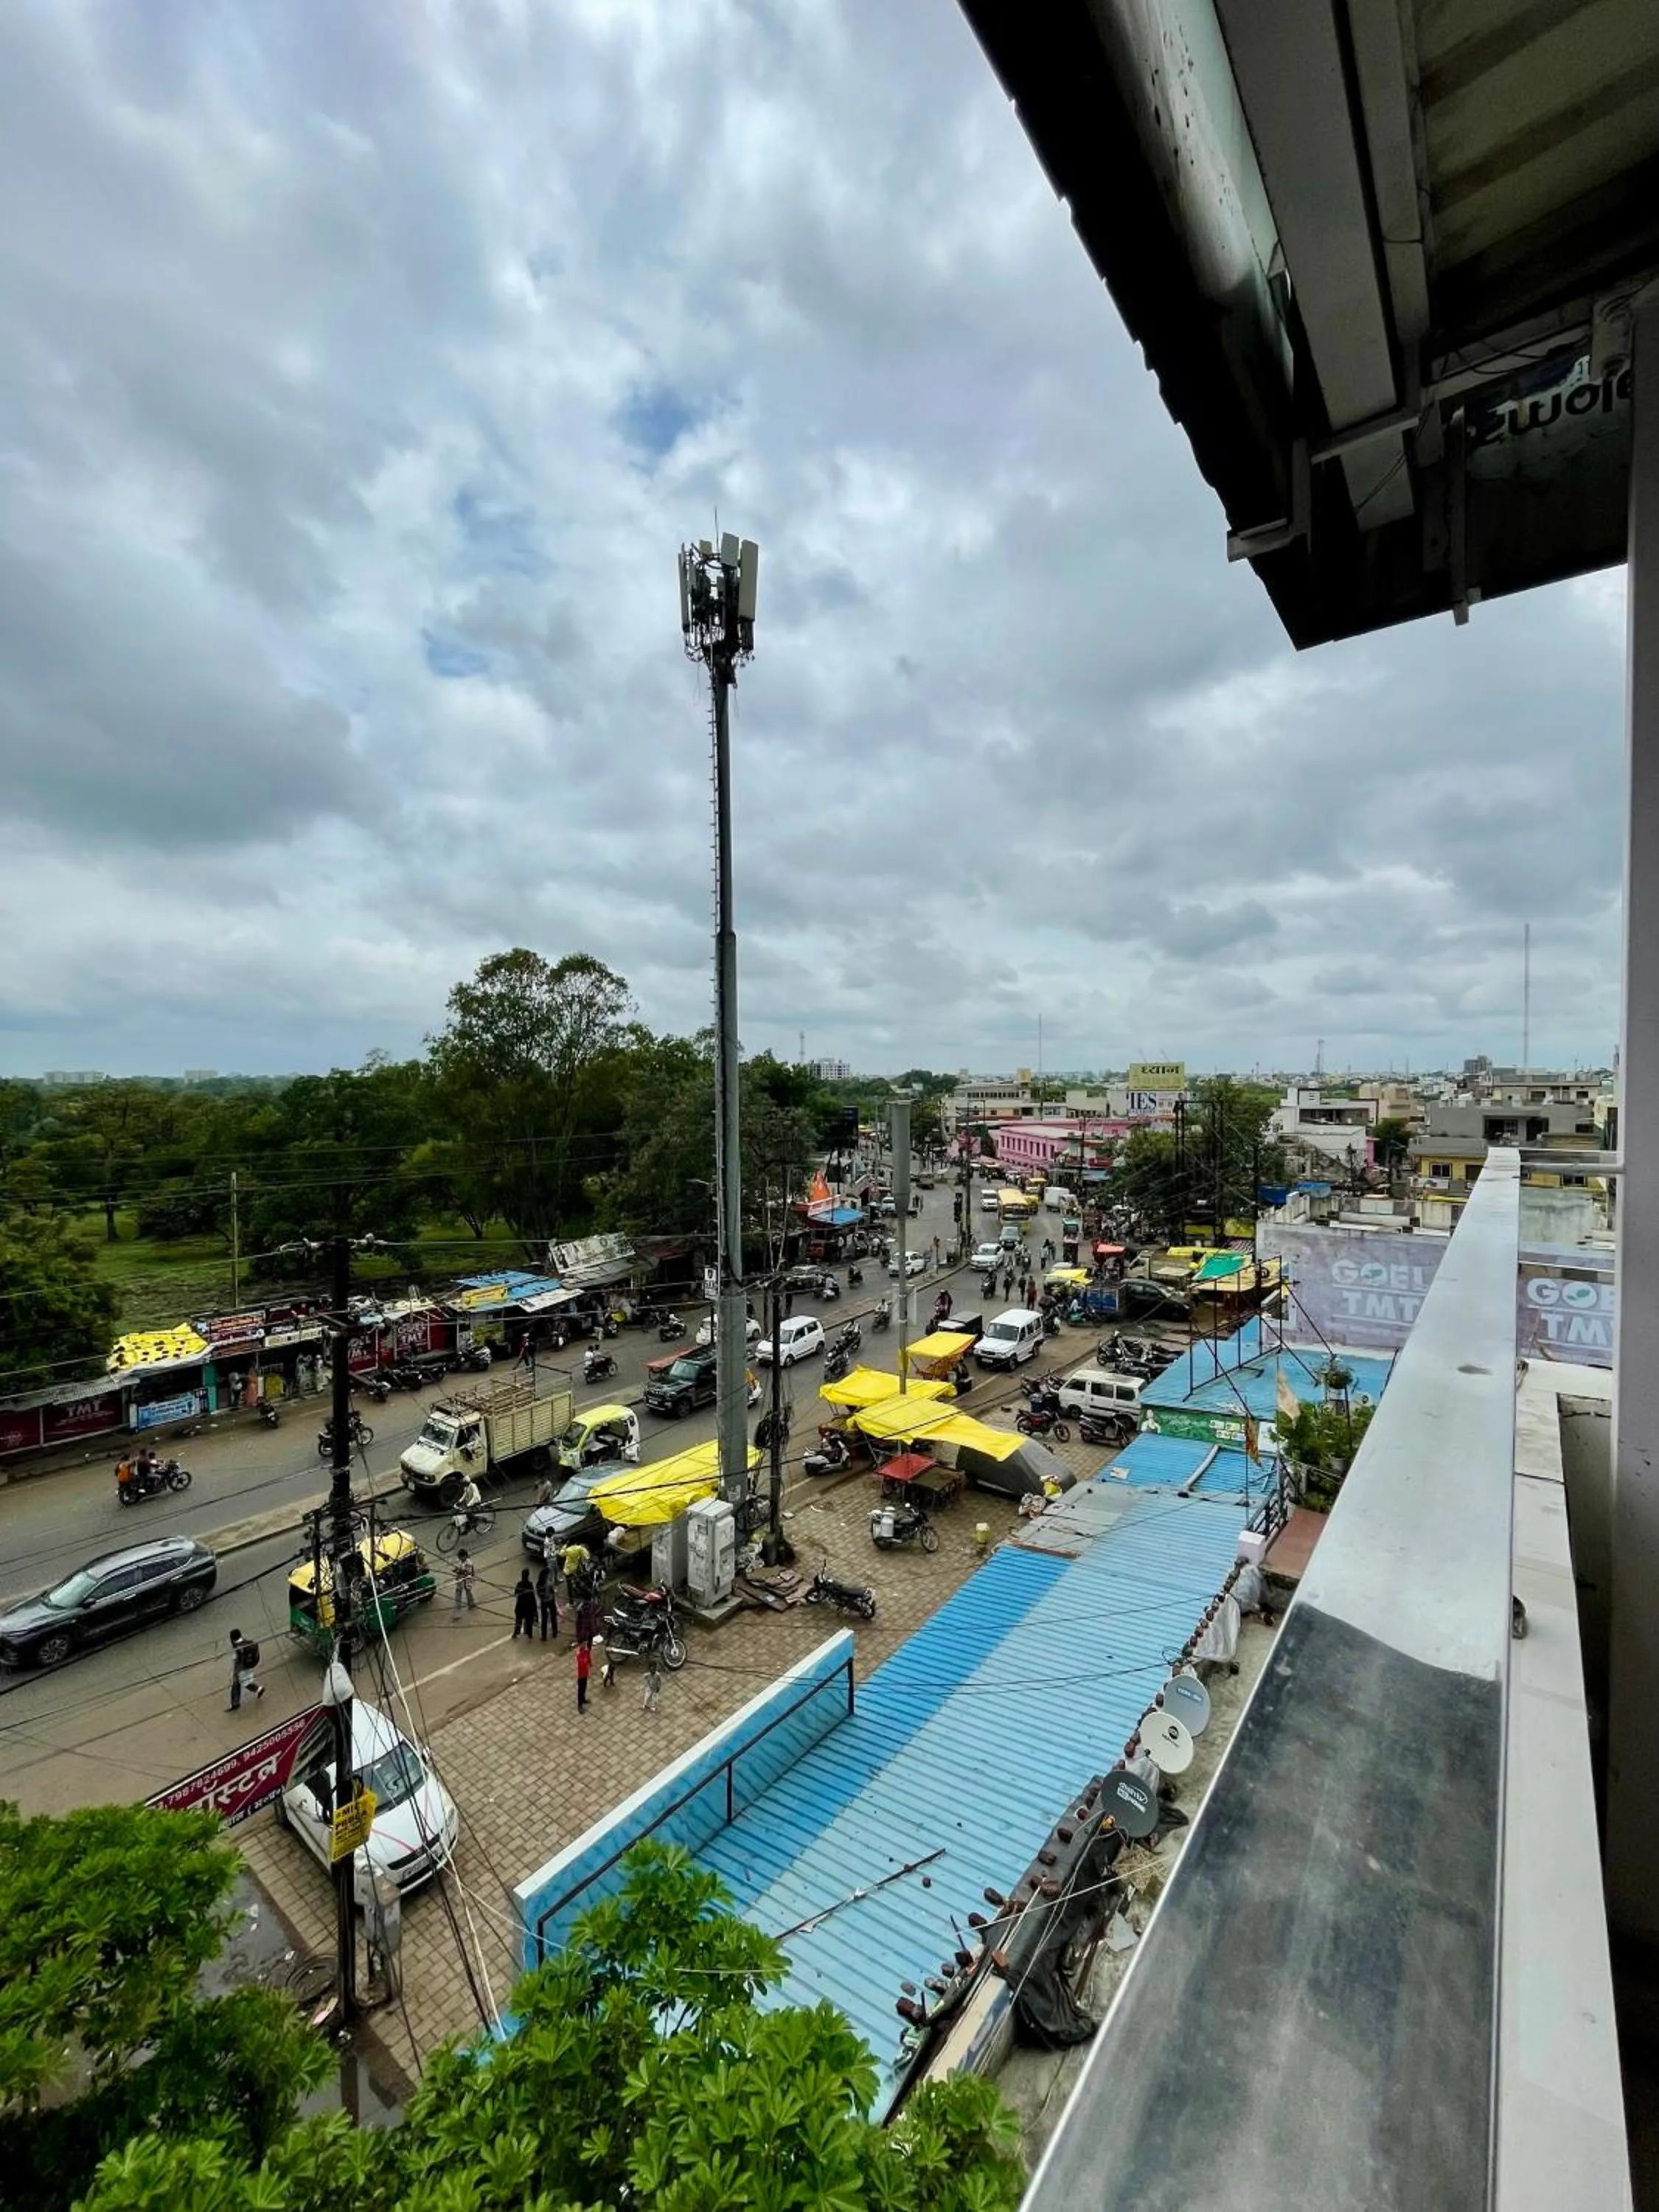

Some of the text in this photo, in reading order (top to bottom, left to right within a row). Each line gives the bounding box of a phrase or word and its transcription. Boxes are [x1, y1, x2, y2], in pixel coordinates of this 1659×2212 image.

[1332, 1259, 1430, 1290] GOEL
[1342, 1290, 1421, 1321] TMT
[1540, 1312, 1615, 1346] TM
